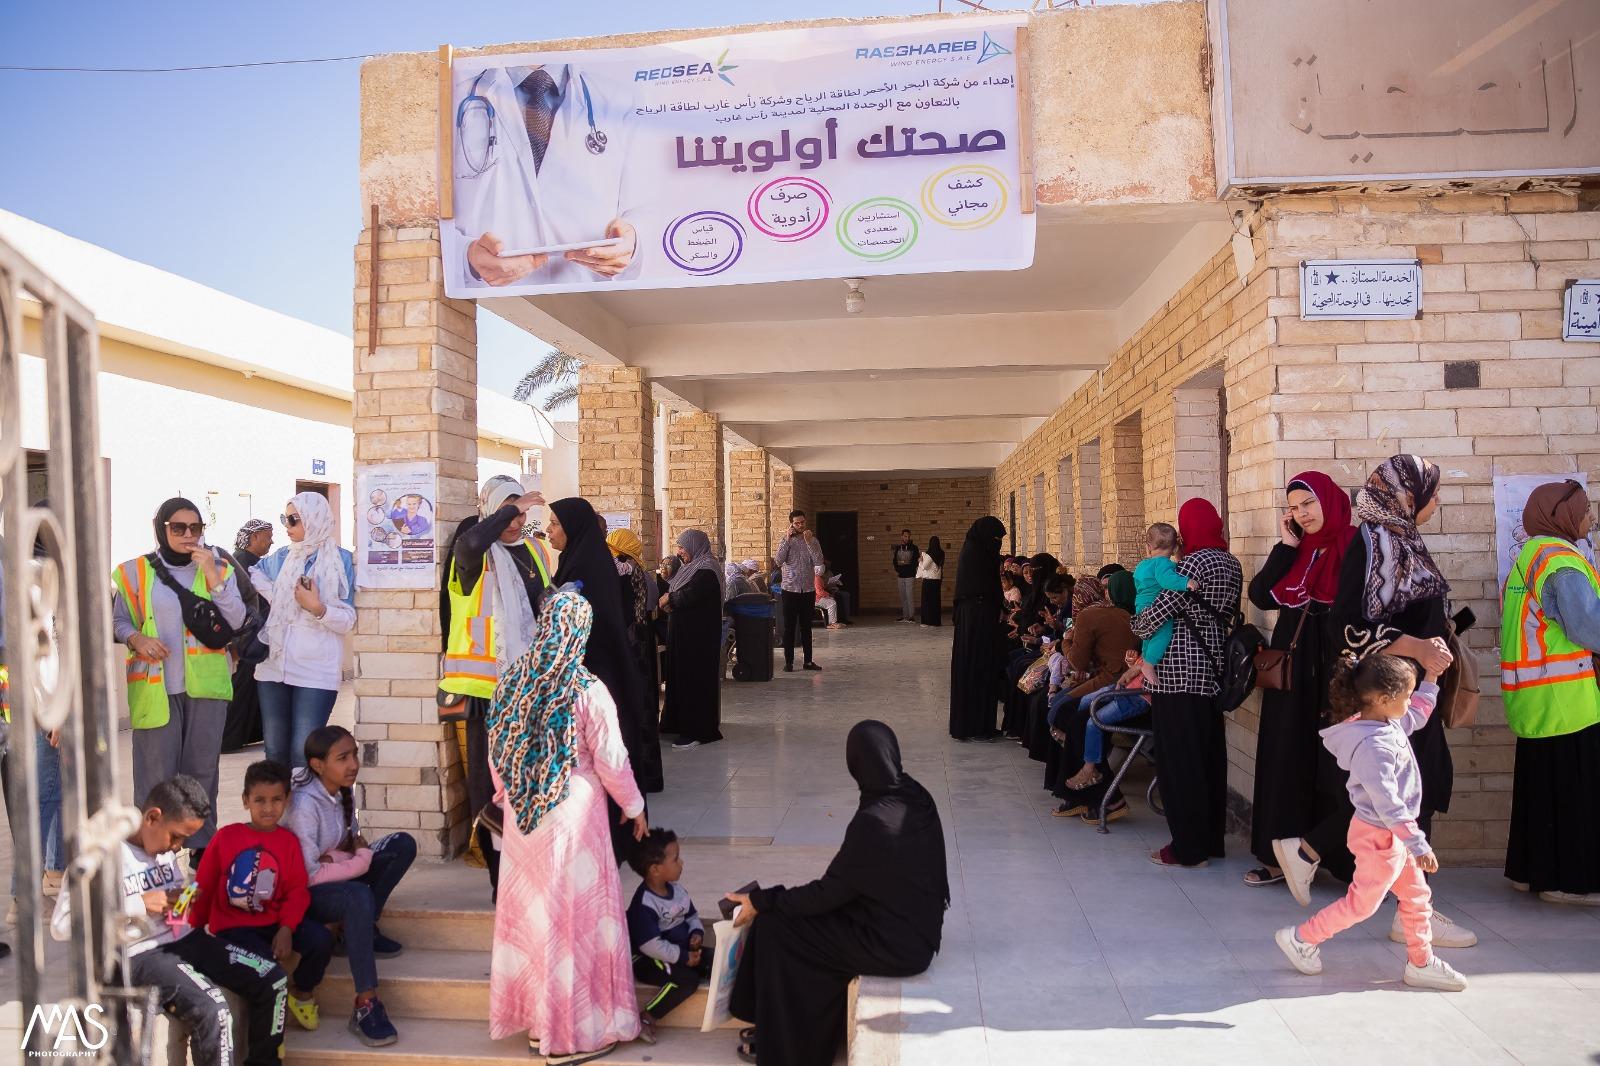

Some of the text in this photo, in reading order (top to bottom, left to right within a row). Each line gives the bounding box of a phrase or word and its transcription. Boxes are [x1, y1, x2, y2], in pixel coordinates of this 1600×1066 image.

[855, 40, 978, 60] RASGHAREB
[890, 60, 913, 68] WIND
[915, 57, 947, 66] ENERGY
[634, 62, 714, 82] REDSEA
[635, 75, 1015, 116] إهداء من شركة البحر الأحمر لطاقة الرياح وشركة رأس غارب لطاقة الرياح
[715, 97, 960, 124] بالتعاون مع الوحدة المحلية لمدينة رأس غارب
[676, 117, 1006, 173] صحتك أولويتنا
[947, 178, 984, 190] كشف
[770, 188, 808, 203] صرف
[772, 207, 811, 227] أدوية
[948, 200, 988, 217] مجاني
[691, 224, 714, 234] قياس
[687, 238, 717, 246] الضغط
[857, 237, 905, 247] التخصصات
[690, 251, 718, 261] والسكر
[1381, 268, 1415, 283] الخدمة
[1311, 292, 1336, 311] الصحية
[1335, 291, 1362, 308] الوحدة
[1570, 307, 1600, 334] مينة
